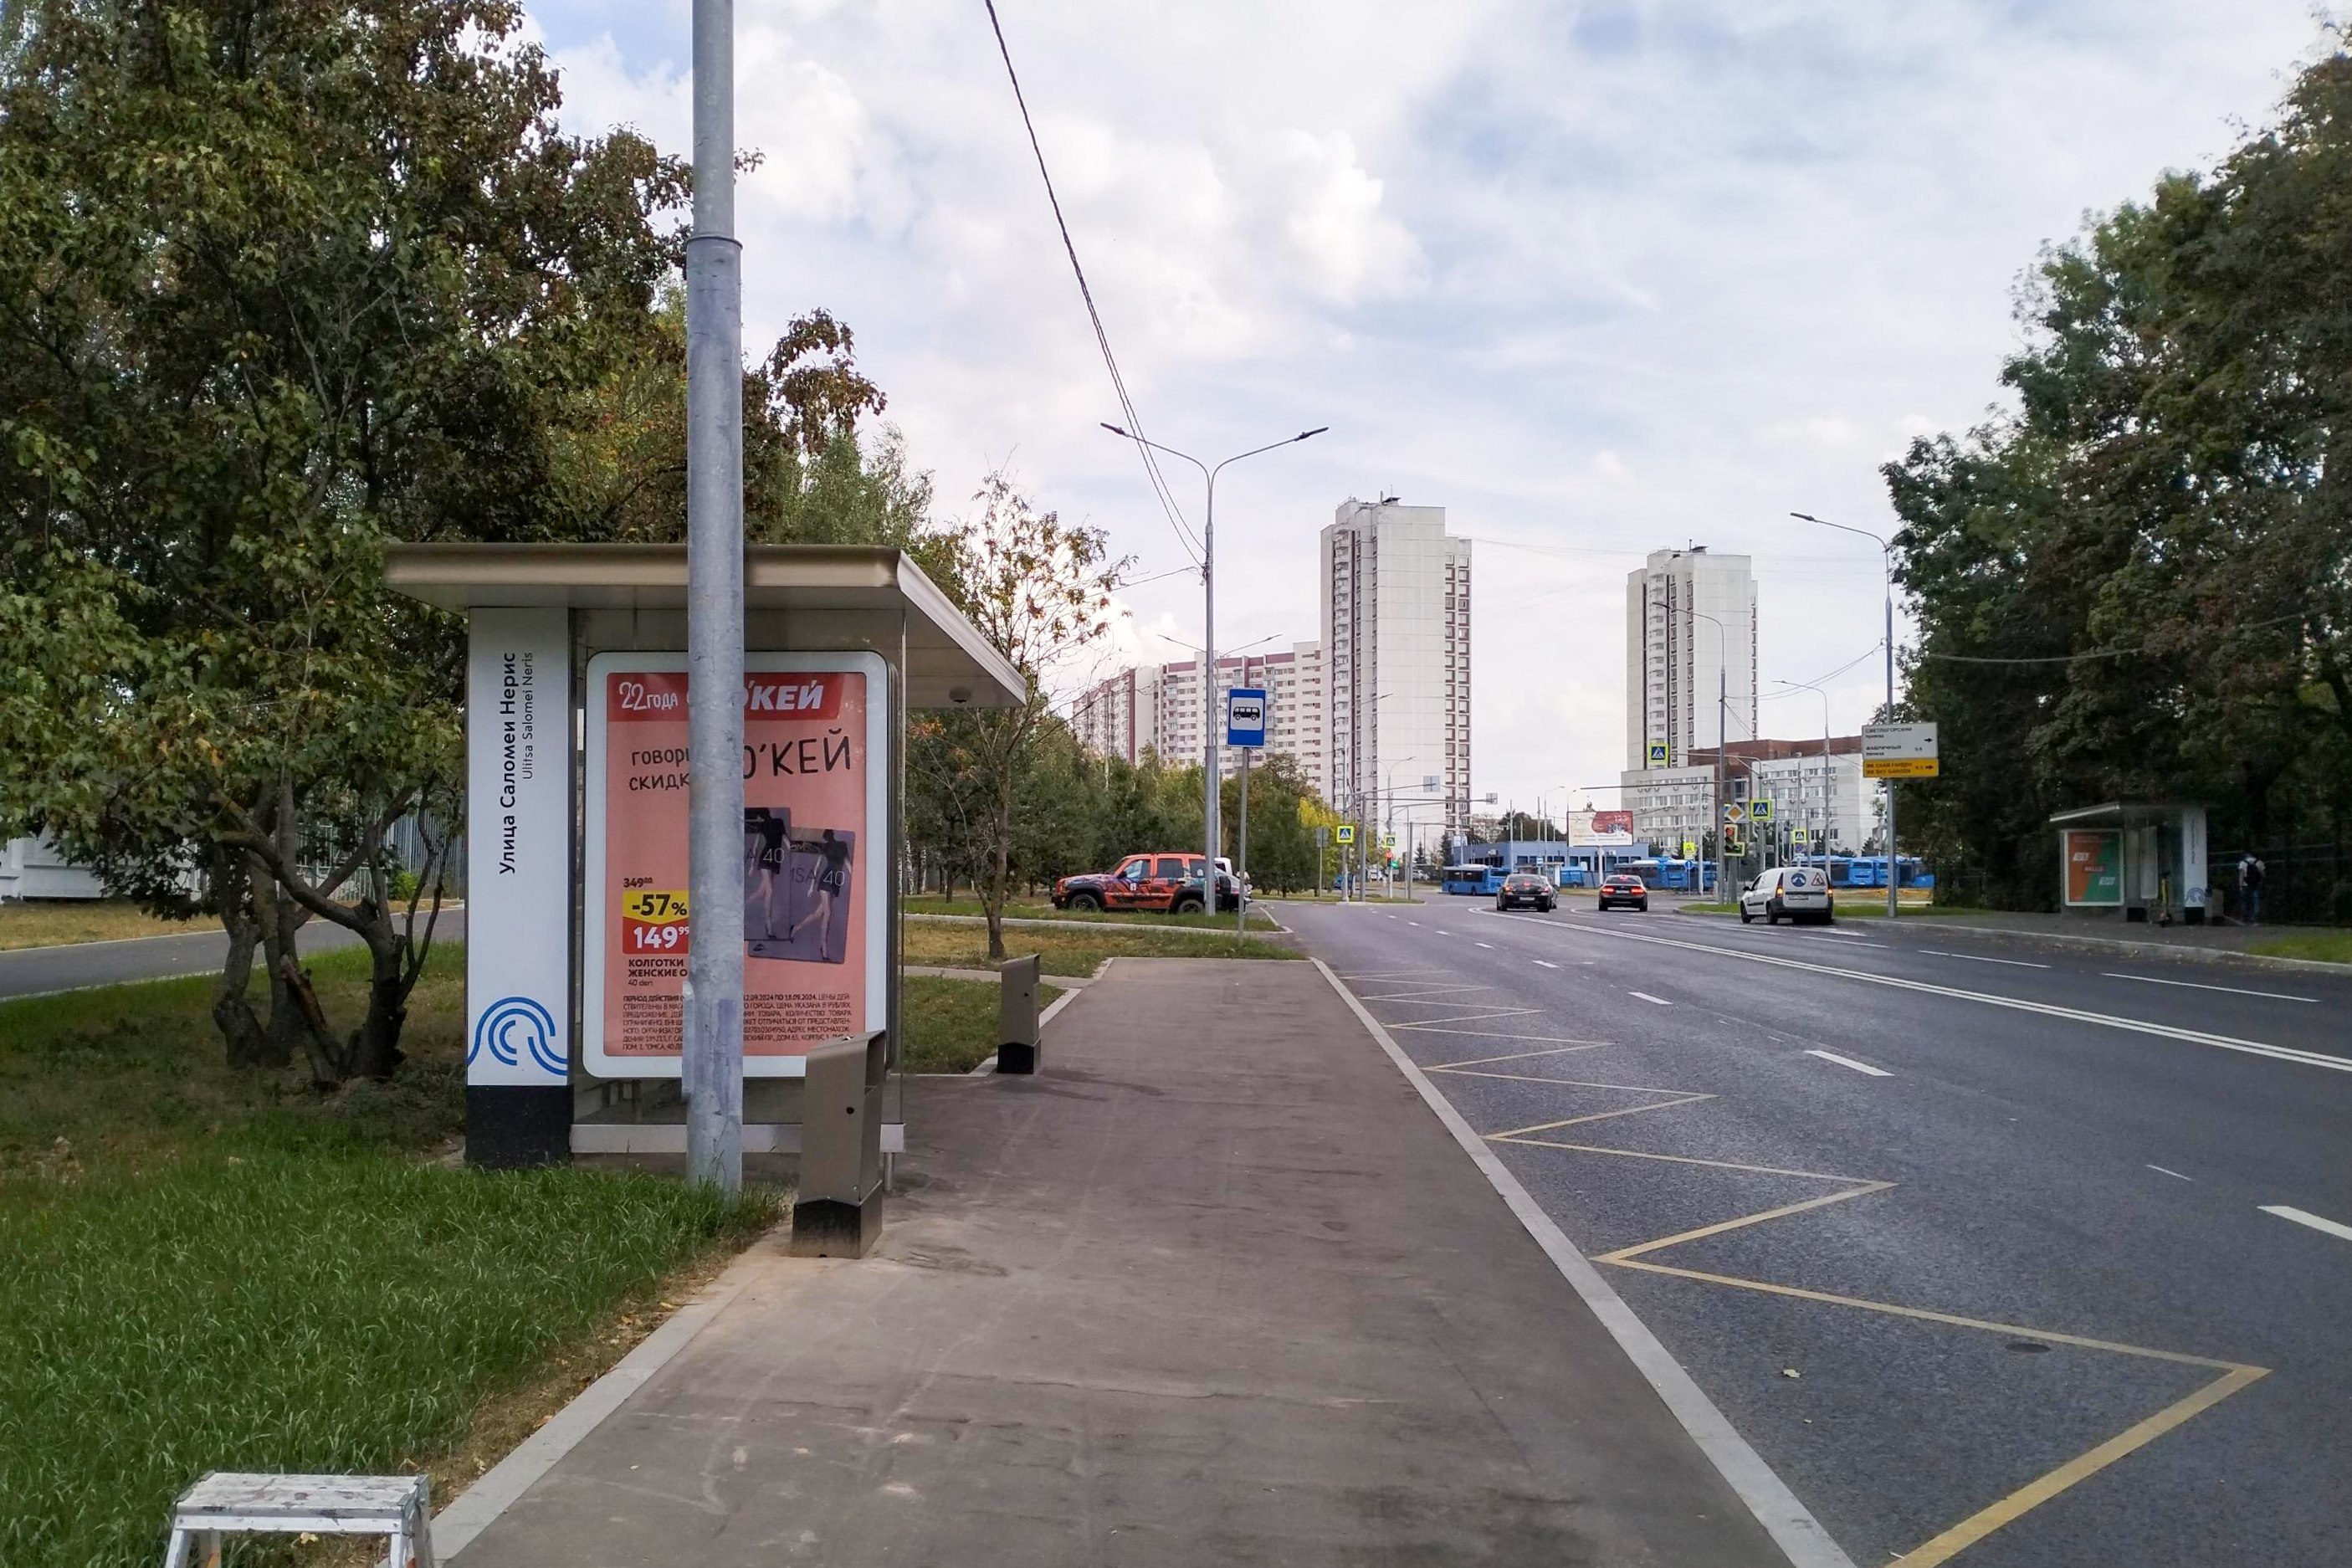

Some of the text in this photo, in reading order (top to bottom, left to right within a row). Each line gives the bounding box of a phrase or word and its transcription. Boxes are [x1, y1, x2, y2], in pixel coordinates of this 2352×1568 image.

[521, 652, 533, 780] Ulitsa Salomei Neris
[500, 653, 519, 875] Улица Саломеи Нерис
[762, 848, 785, 863] 40
[822, 870, 845, 886] 40
[628, 959, 684, 967] КОЛГОТКИ
